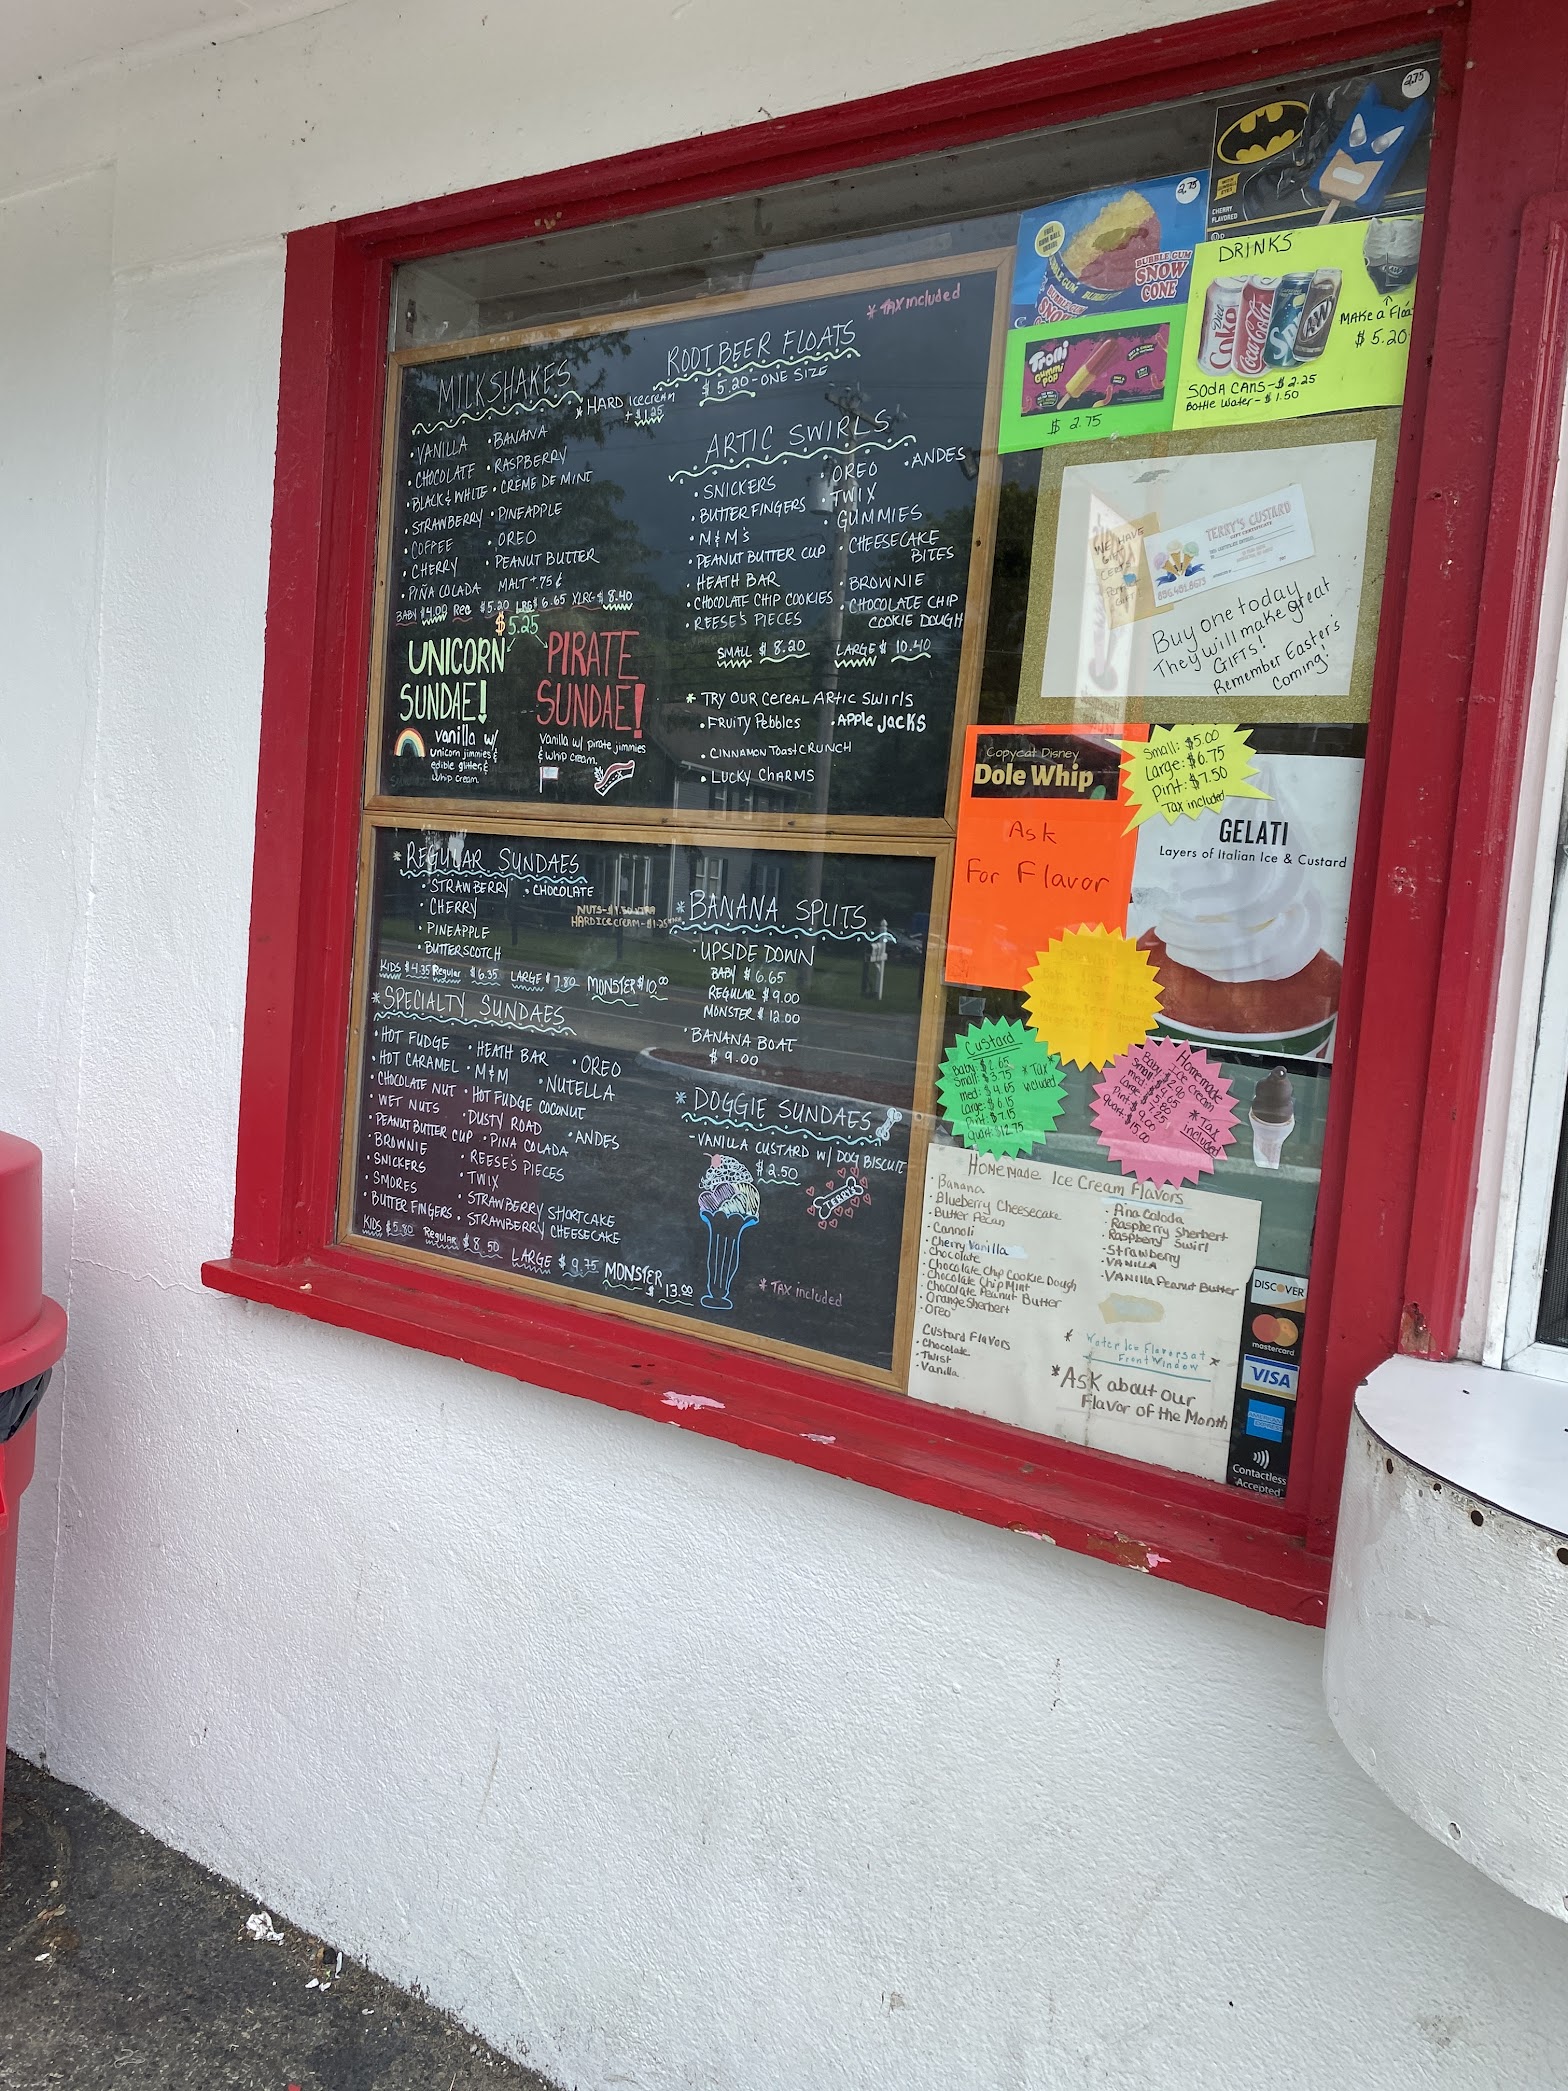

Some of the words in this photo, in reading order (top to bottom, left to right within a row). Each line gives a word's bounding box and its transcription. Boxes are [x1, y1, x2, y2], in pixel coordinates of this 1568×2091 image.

[1211, 213, 1238, 223] FLAVORED
[1212, 206, 1233, 215] CHERRY
[1136, 253, 1170, 268] BUBBLE
[1172, 251, 1191, 260] GUM
[1135, 261, 1188, 285] SNOW
[1141, 280, 1178, 302] CONE
[1211, 304, 1225, 329] Diet
[1303, 297, 1333, 340] A&W
[668, 344, 713, 376] ROOT
[719, 332, 771, 364] BEER
[783, 320, 856, 354] FLOATS
[1029, 340, 1069, 372] Trolli
[438, 359, 571, 412] MILKSHAKES
[493, 425, 548, 449] BANANA
[705, 426, 772, 463] ARTIC
[789, 410, 890, 446] SWIRLS
[417, 436, 468, 465] VANILLA
[494, 446, 568, 473] RASPBERRY
[911, 448, 966, 468] ANDES
[415, 463, 475, 488] CHOCOLATE
[832, 462, 877, 482] OREO
[703, 477, 776, 499] SNICKERS
[832, 482, 877, 506] TWIX
[412, 509, 483, 535] STRAWBERRY
[837, 505, 923, 529] GUMMIES
[1205, 519, 1245, 541] TERRY'S
[1249, 501, 1292, 526] CUSTARD
[498, 530, 536, 547] OREO
[849, 530, 939, 553] CHEESECAKE
[911, 547, 954, 563] BITES
[411, 558, 458, 580] CHERRY
[697, 575, 740, 589] HEATH
[747, 571, 780, 588] BAR
[439, 583, 481, 598] COLADA
[849, 574, 926, 591] BROWNIE
[694, 611, 747, 630] REESE'S
[755, 613, 802, 627] PIECES
[1153, 626, 1196, 654] Buy
[1201, 610, 1233, 632] one
[1238, 582, 1300, 615] today
[1153, 656, 1201, 678] They
[1203, 631, 1238, 657] will
[1241, 611, 1285, 637] make
[1287, 576, 1330, 623] great
[408, 637, 506, 676] UNICORN
[548, 630, 639, 680] PIRATE
[1214, 656, 1281, 694] Remember
[400, 680, 487, 724] SUNDAE!
[536, 679, 646, 738] SUNDAE!
[987, 748, 1037, 762] Copycat
[1042, 748, 1079, 762] Disney
[1144, 741, 1180, 760] Small:
[1185, 729, 1219, 749] $5.00
[1146, 759, 1185, 781] Large:
[1187, 745, 1226, 769] $6.75
[974, 763, 1027, 786] Dole
[1031, 763, 1093, 792] Whip
[1189, 766, 1227, 790] $7.50
[1161, 802, 1183, 813] Tax
[1188, 791, 1225, 810] included
[1009, 821, 1057, 844] Ask
[1219, 818, 1289, 846] GELATI
[406, 841, 484, 872] REGULAR
[498, 848, 580, 874] SUNDAES
[1160, 846, 1197, 859] Layers
[1202, 848, 1214, 858] of
[1218, 850, 1255, 862] Italian
[1260, 853, 1278, 863] Ice
[1284, 854, 1292, 864] &
[1298, 854, 1347, 868] Custard
[967, 858, 999, 884] For
[1018, 861, 1109, 892] Flavor
[532, 884, 594, 897] CHOCOLATE
[430, 898, 478, 919] CHERRY
[689, 890, 778, 922] BANANA
[796, 899, 867, 930] SPLITS
[424, 941, 501, 960] BUTTERSCOTCH
[383, 986, 465, 1017] SPECIALTY
[479, 992, 565, 1024] SUNDAES
[381, 1028, 403, 1043] HOT
[408, 1031, 450, 1050] FUDGE
[692, 1028, 752, 1047] BANANA
[757, 1035, 797, 1053] BOAT
[965, 1032, 1015, 1055] Custard
[580, 1056, 621, 1078] OREO
[1032, 1063, 1048, 1075] Tax
[1176, 1050, 1223, 1104] Homemade
[545, 1077, 615, 1101] NUTELLA
[1024, 1076, 1056, 1092] included
[1168, 1063, 1188, 1085] Ice
[1188, 1084, 1215, 1112] Cream
[694, 1087, 768, 1119] DOGGIE
[778, 1100, 872, 1131] SUNDAES
[374, 1133, 427, 1154] BROWNIE
[697, 1133, 748, 1150] VANILLA
[755, 1140, 809, 1158] CUSTARD
[836, 1152, 859, 1169] DOG
[863, 1158, 907, 1174] BISCUIT
[374, 1154, 427, 1173] SNICKERS
[373, 1174, 418, 1193] SMORES
[467, 1170, 500, 1189] TWIX
[938, 1174, 985, 1193] Banana
[1053, 1171, 1073, 1186] Ice
[1078, 1175, 1124, 1196] Cream
[1131, 1183, 1184, 1204] Flavors
[467, 1192, 544, 1217] STRAWBERRY
[548, 1206, 615, 1227] SHORTCAKE
[934, 1207, 969, 1221] Butter
[973, 1213, 1005, 1226] Pecan
[936, 1192, 991, 1215] Blueberry
[996, 1200, 1062, 1220] Cheesecake
[933, 1222, 974, 1236] Cannoli
[1107, 1246, 1180, 1268] Strawberry
[770, 1281, 791, 1296] TAX
[795, 1282, 843, 1307] included
[1254, 1279, 1304, 1297] DISCOVER
[925, 1304, 951, 1317] Oreo
[923, 1324, 965, 1342] Custard
[970, 1332, 1011, 1350] Flavors
[1252, 1342, 1295, 1356] mastercard
[1250, 1366, 1290, 1388] VISA
[1107, 1378, 1157, 1397] about
[1161, 1389, 1196, 1407] our
[1081, 1394, 1130, 1414] Flavor
[1136, 1404, 1154, 1417] of
[1159, 1406, 1180, 1421] the
[1185, 1411, 1228, 1430] Month
[1248, 1411, 1282, 1424] AMERICAN
[1254, 1420, 1283, 1431] EXPRESS
[1233, 1463, 1287, 1486] Contactless
[1236, 1479, 1281, 1497] Accepted
